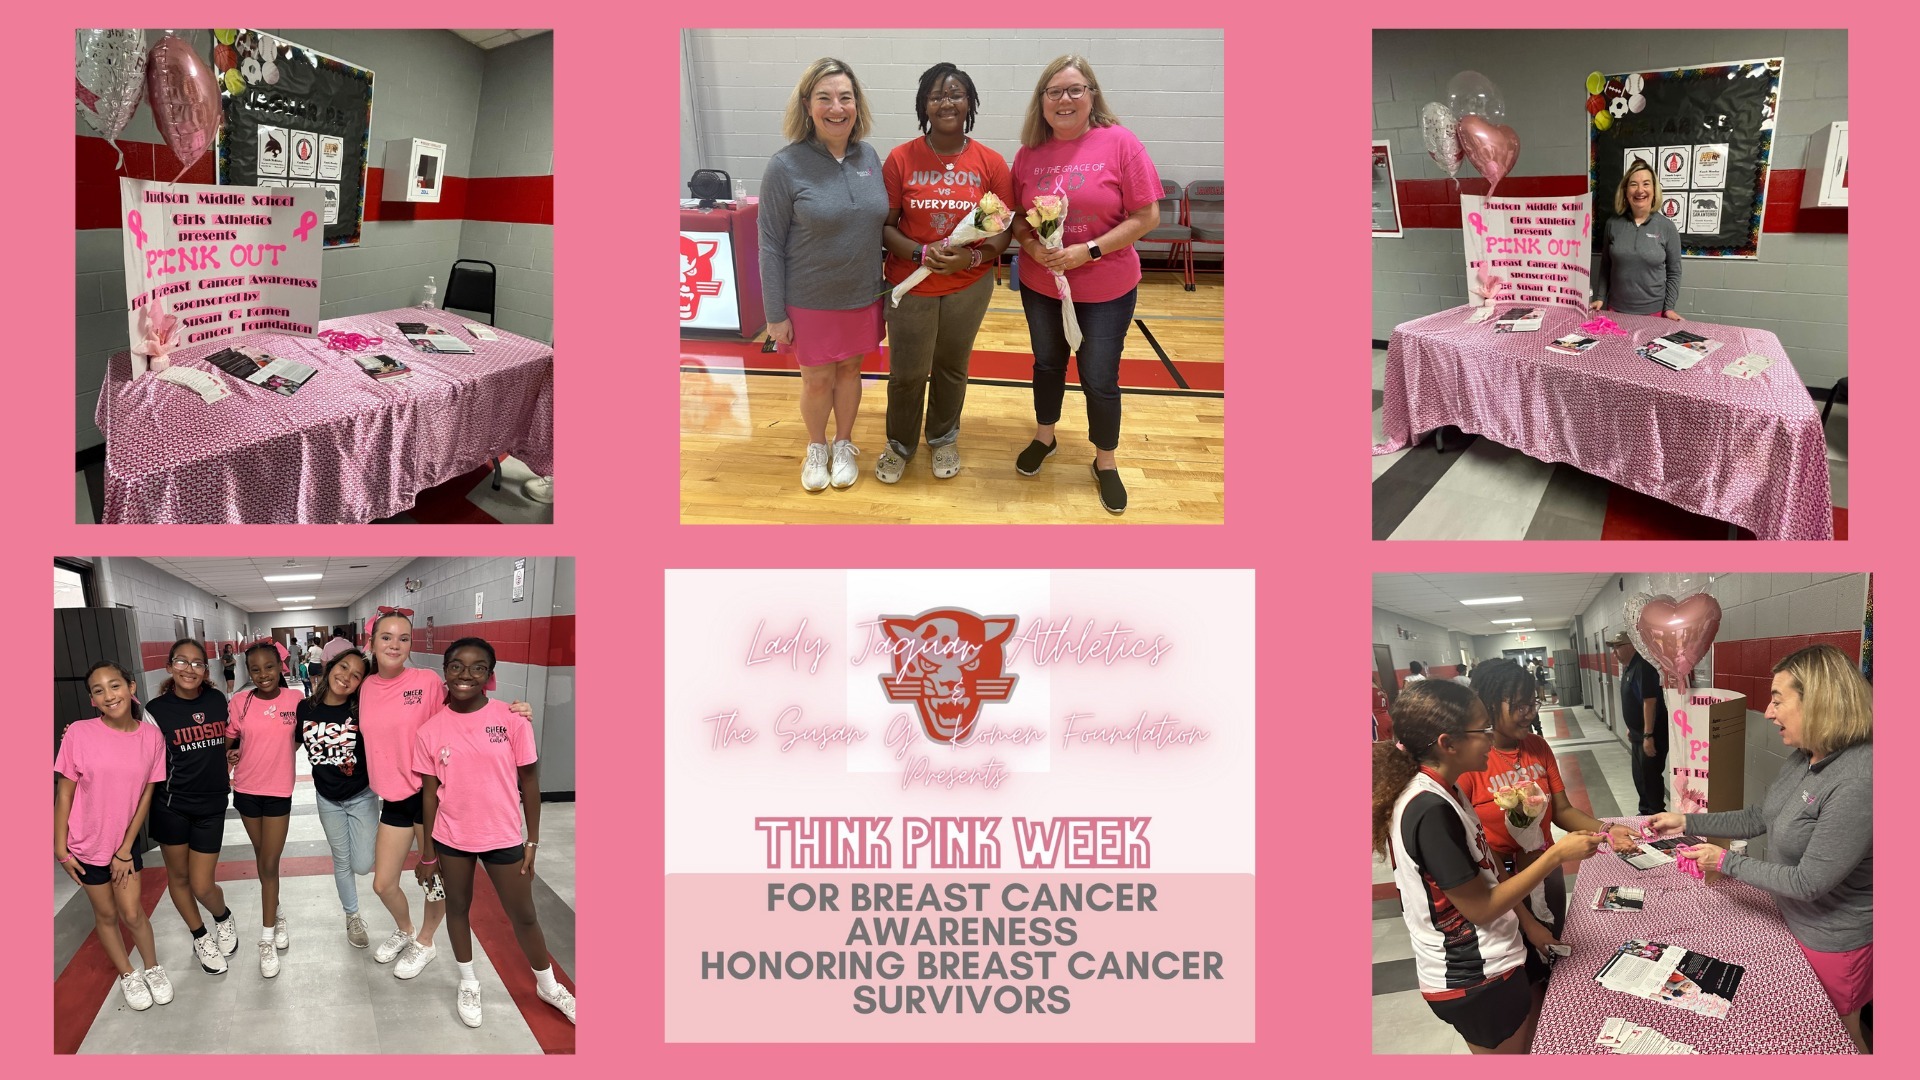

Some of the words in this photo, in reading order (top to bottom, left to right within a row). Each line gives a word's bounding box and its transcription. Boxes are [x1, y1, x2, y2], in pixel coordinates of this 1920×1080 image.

[1034, 167, 1044, 175] BY
[1047, 165, 1061, 174] THE
[1062, 163, 1090, 173] GRACE
[1092, 163, 1105, 172] OF
[908, 170, 982, 188] JUDSON
[144, 190, 189, 204] Judson
[197, 193, 245, 206] Middle
[252, 195, 295, 207] School
[910, 199, 978, 211] EVERYBODY
[1525, 202, 1557, 211] Middle
[172, 213, 206, 226] Girls
[214, 213, 272, 226] Athletics
[1510, 216, 1531, 225] Girls
[1536, 217, 1576, 226] Athletics
[178, 229, 237, 242] presents
[1513, 228, 1552, 236] presents
[1485, 236, 1542, 255] PINK
[1547, 238, 1581, 258] OUT
[146, 245, 221, 279] PINK
[229, 243, 287, 268] OUT
[1491, 259, 1523, 267] Breast
[1526, 260, 1558, 269] Cancer
[198, 276, 244, 290] Cancer
[249, 273, 318, 289] Awareness
[1510, 272, 1556, 281] sponsored
[1557, 274, 1569, 282] by
[1516, 283, 1543, 292] Susan
[173, 292, 241, 312] sponsored
[243, 291, 260, 302] by
[1520, 294, 1551, 303] Cancer
[182, 313, 222, 328] Susan
[228, 308, 242, 320] G.
[246, 306, 290, 318] Komen
[187, 326, 234, 343] Cancer
[241, 320, 313, 334] Foundation
[302, 720, 359, 749] RISE
